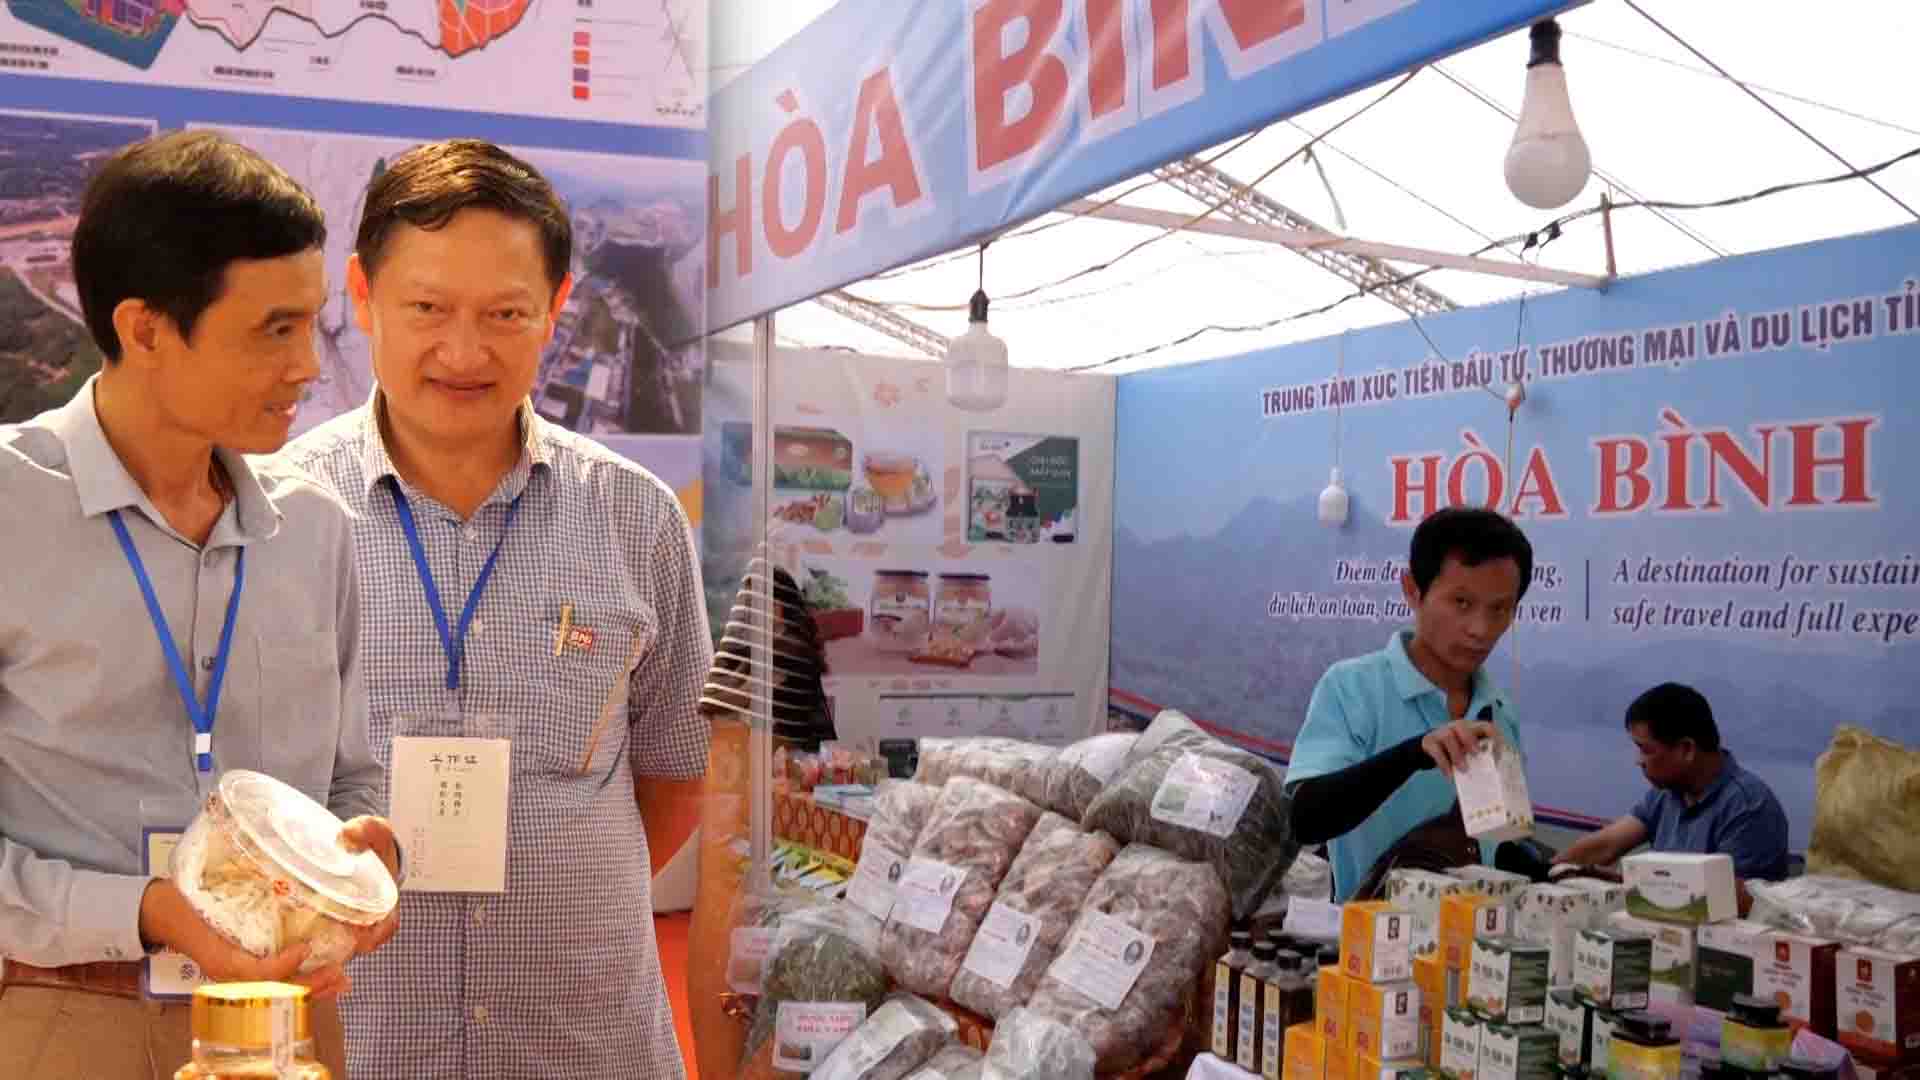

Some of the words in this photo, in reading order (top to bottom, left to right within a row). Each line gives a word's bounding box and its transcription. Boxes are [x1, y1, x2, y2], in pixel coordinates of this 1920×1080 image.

[705, 66, 921, 287] HÒA
[1264, 385, 1314, 415] TRUNG
[1540, 335, 1633, 375] THƯƠNG
[1644, 327, 1695, 366] MẠI
[1706, 313, 1740, 354] VÀ
[1752, 313, 1790, 348] DU
[1802, 301, 1872, 348] LỊCH
[1886, 280, 1920, 332] TỈ
[1391, 431, 1565, 521] HÒA
[1594, 409, 1873, 513] BÌNH
[1613, 597, 1656, 631] safe
[1663, 600, 1734, 628] travel
[1739, 602, 1789, 630] and
[1791, 602, 1846, 638] full
[1614, 559, 1629, 584] A
[1637, 556, 1770, 584] destination
[1776, 555, 1818, 590] for
